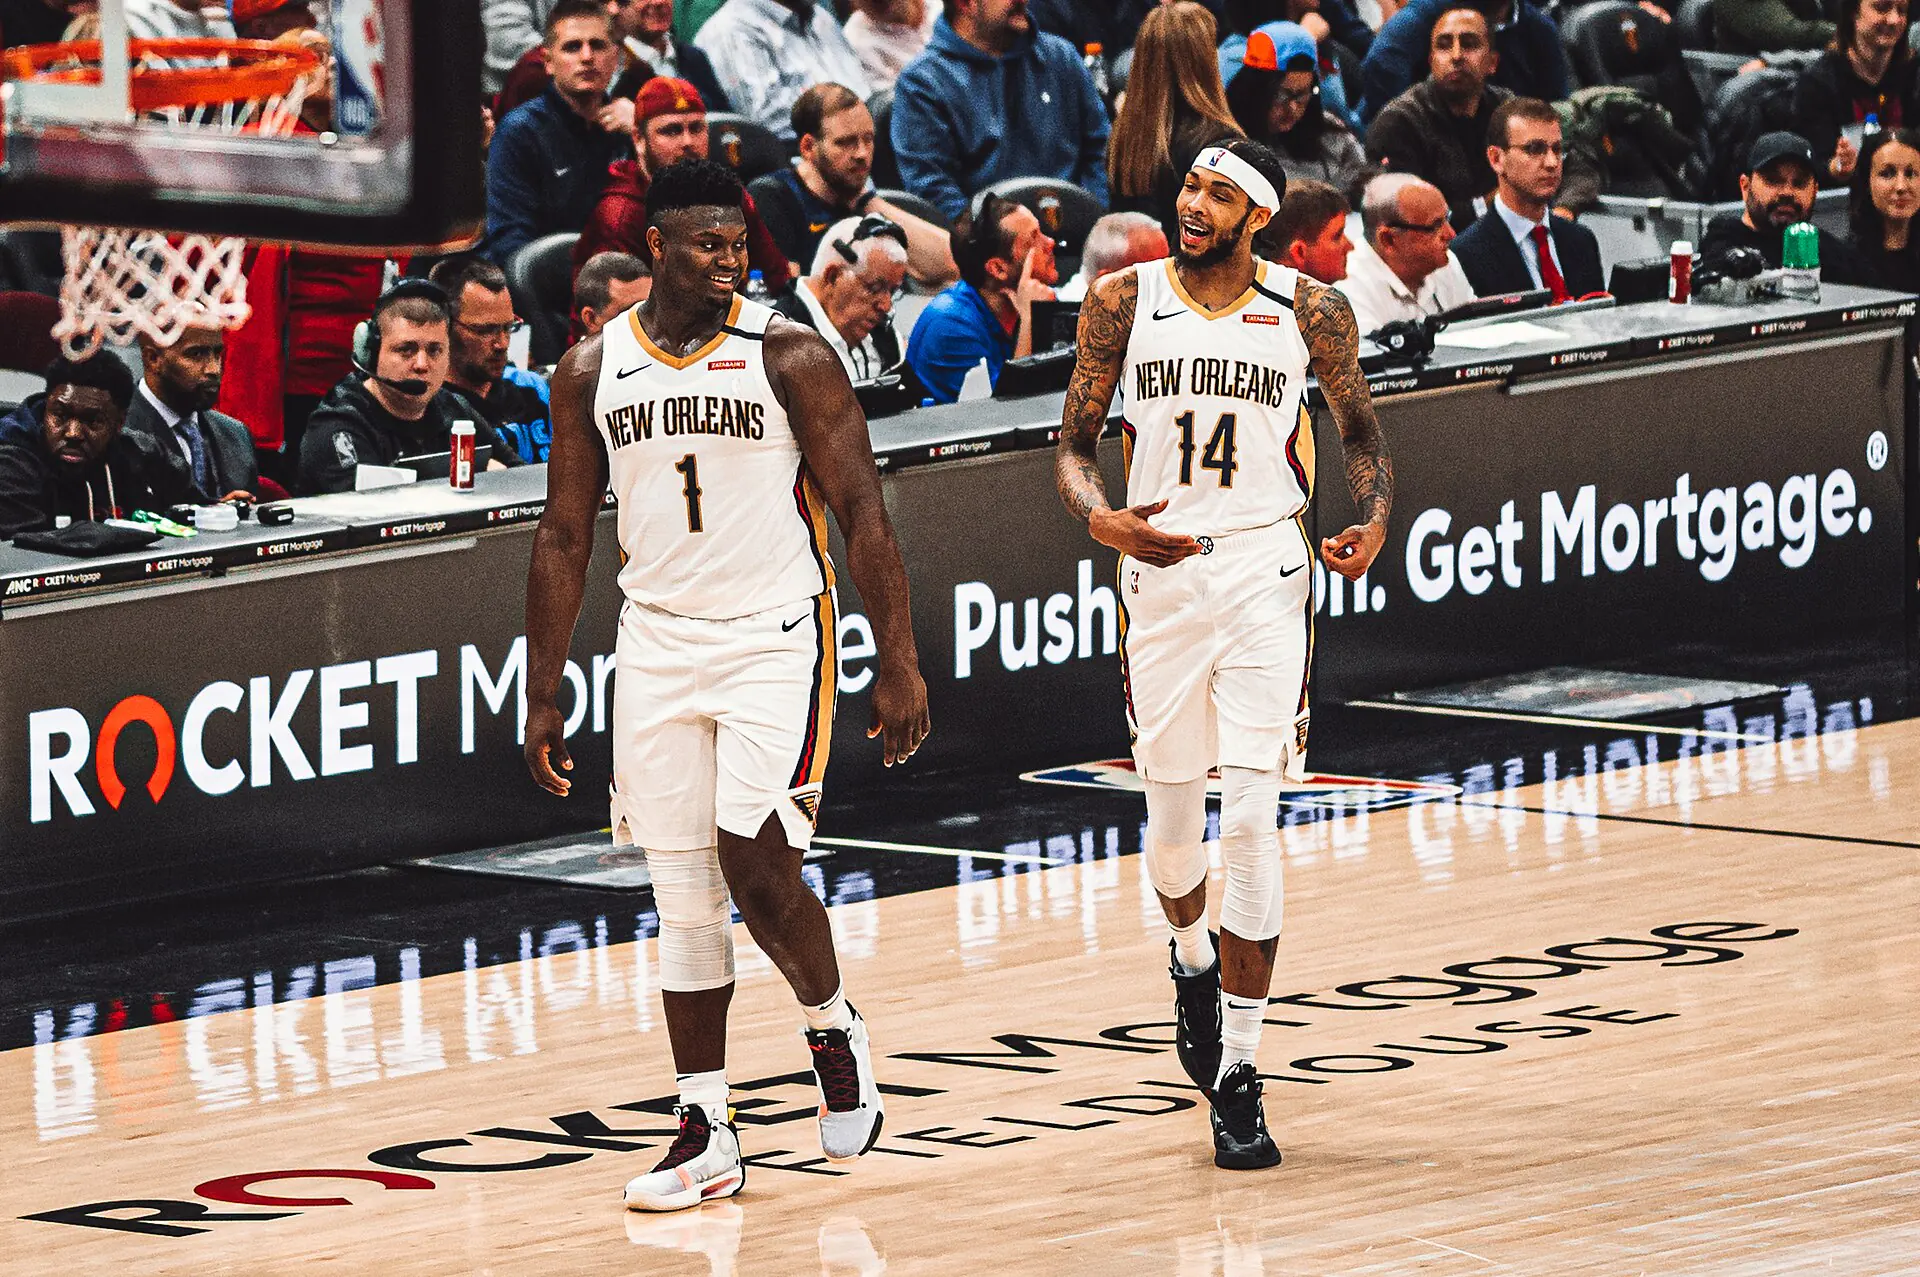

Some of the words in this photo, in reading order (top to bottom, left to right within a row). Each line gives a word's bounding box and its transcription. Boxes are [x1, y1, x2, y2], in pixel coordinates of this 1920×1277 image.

[1135, 358, 1184, 402] NEW
[1190, 357, 1287, 409] ORLEANS
[604, 400, 655, 451] NEW
[662, 396, 764, 441] ORLEANS
[929, 444, 959, 457] ROCKET
[959, 440, 992, 453] Mortgage
[1174, 410, 1238, 488] 14
[487, 507, 519, 521] ROCKET
[674, 454, 703, 533] 1
[256, 543, 289, 556] ROCKET
[289, 539, 324, 551] Mortgage
[380, 523, 412, 537] ROCKET
[412, 520, 446, 533] Mortgage
[1405, 500, 1524, 603] Get
[1541, 467, 1873, 583] Mortgage.
[5, 578, 32, 595] ANC
[33, 575, 66, 588] ROCKET
[66, 572, 101, 584] Mortgage
[145, 559, 178, 573] ROCKET
[179, 556, 213, 568] Mortgage
[955, 559, 1117, 679] Push
[29, 650, 438, 823] ROCKET
